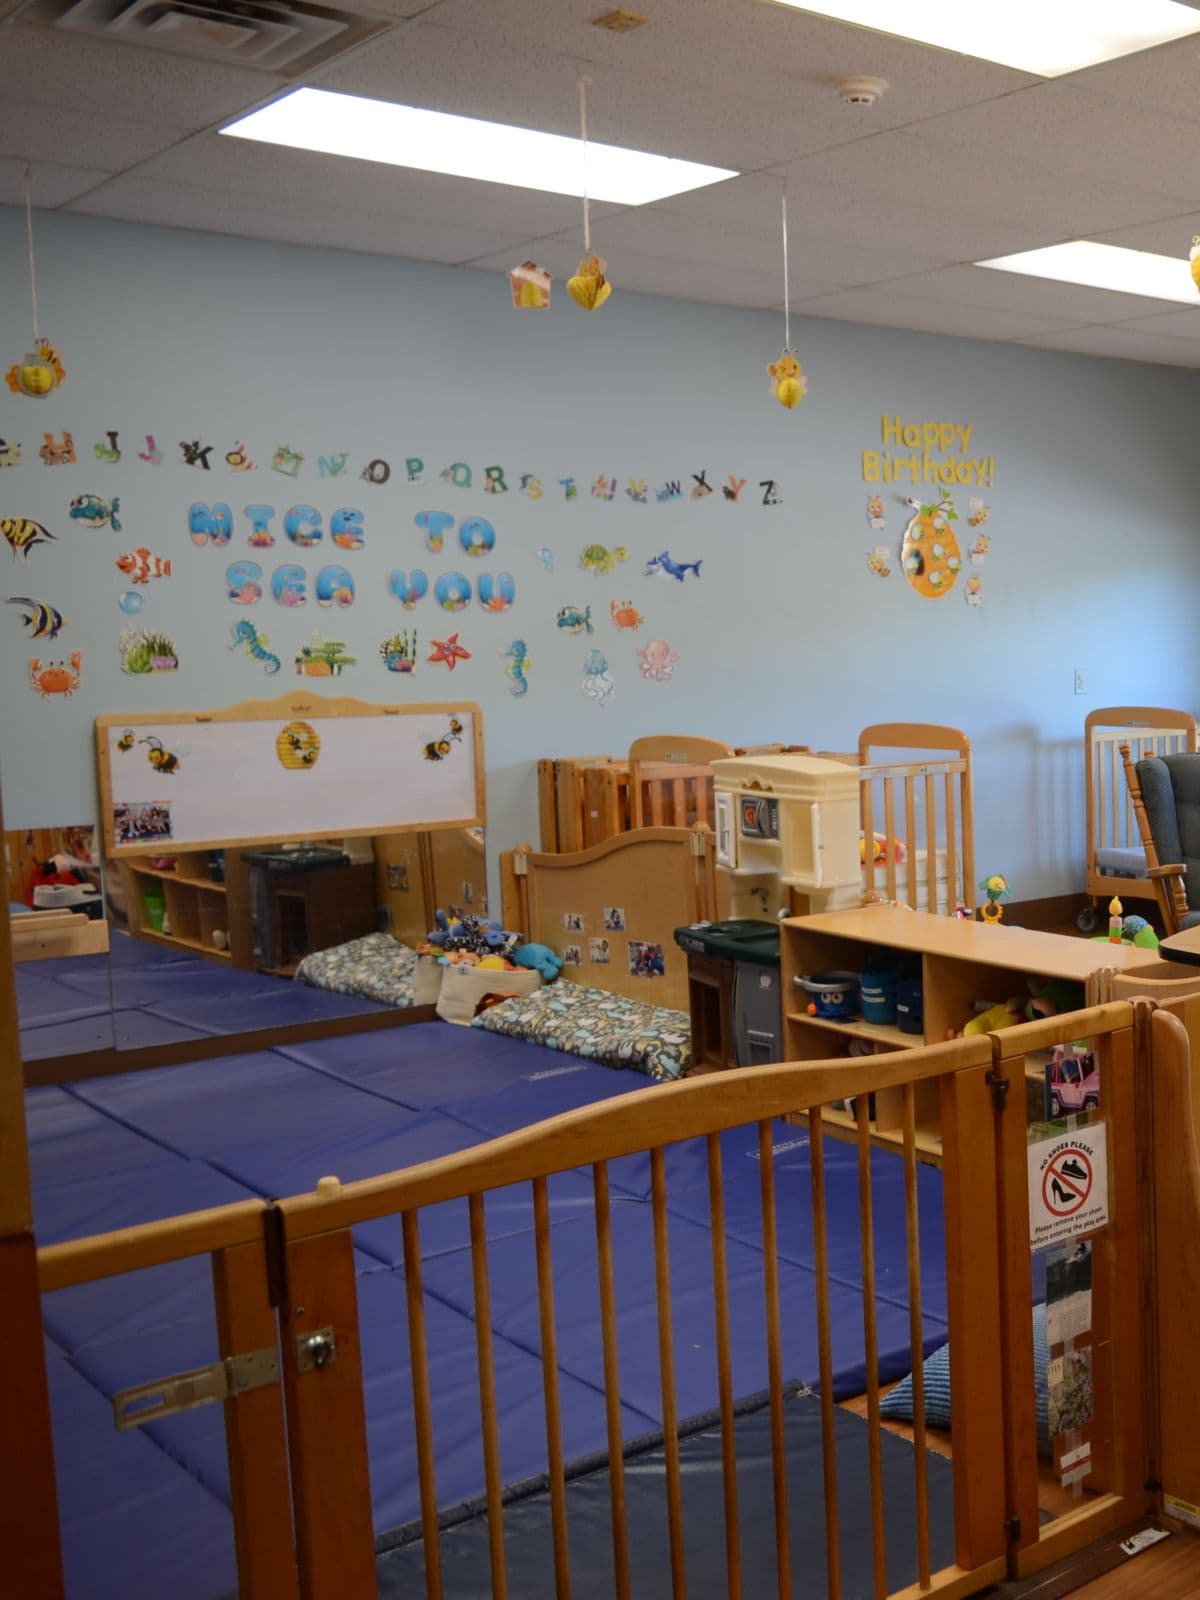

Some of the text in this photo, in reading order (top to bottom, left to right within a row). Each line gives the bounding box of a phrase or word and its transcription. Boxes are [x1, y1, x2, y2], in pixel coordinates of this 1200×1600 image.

[881, 413, 973, 454] Happy
[179, 440, 214, 471] K
[364, 458, 392, 484] O
[404, 457, 426, 484] P
[485, 465, 508, 495] R
[691, 469, 712, 501] X
[862, 449, 995, 488] Birthday!
[188, 502, 498, 557] NICE TO
[389, 569, 516, 613] YOU
[1040, 1141, 1094, 1171] NO SHOES PLEASE
[1031, 1235, 1049, 1246] before
[1050, 1227, 1072, 1240] entering
[1073, 1223, 1083, 1231] the
[1084, 1219, 1095, 1229] play
[1035, 1206, 1103, 1234] Please remove your shoes
